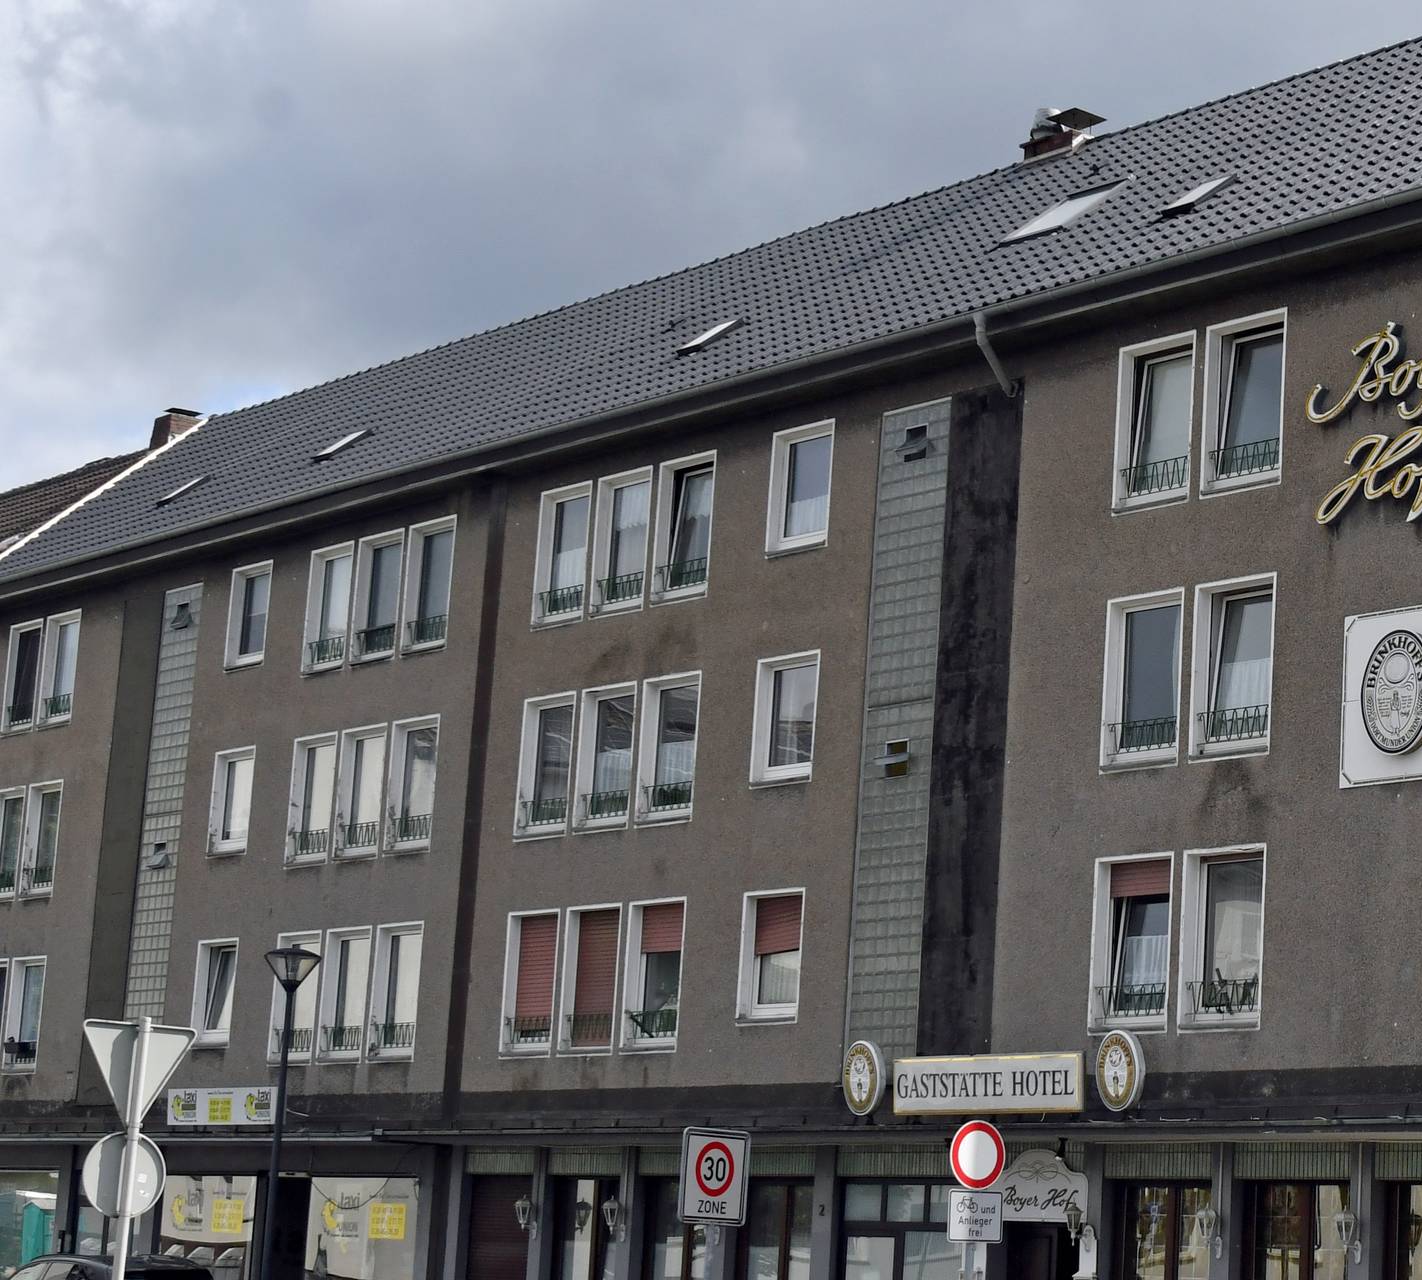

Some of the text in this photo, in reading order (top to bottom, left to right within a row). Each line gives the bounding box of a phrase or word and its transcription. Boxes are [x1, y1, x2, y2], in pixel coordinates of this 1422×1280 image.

[897, 1069, 1075, 1098] GASTSTÄTTE HOTEL
[703, 1156, 727, 1182] 30
[1004, 1185, 1079, 1212] Boyer Hof
[697, 1200, 727, 1215] ZONE
[818, 1204, 825, 1216] 2
[981, 1206, 995, 1214] und
[958, 1216, 992, 1226] Anlieger
[968, 1228, 982, 1237] frei
